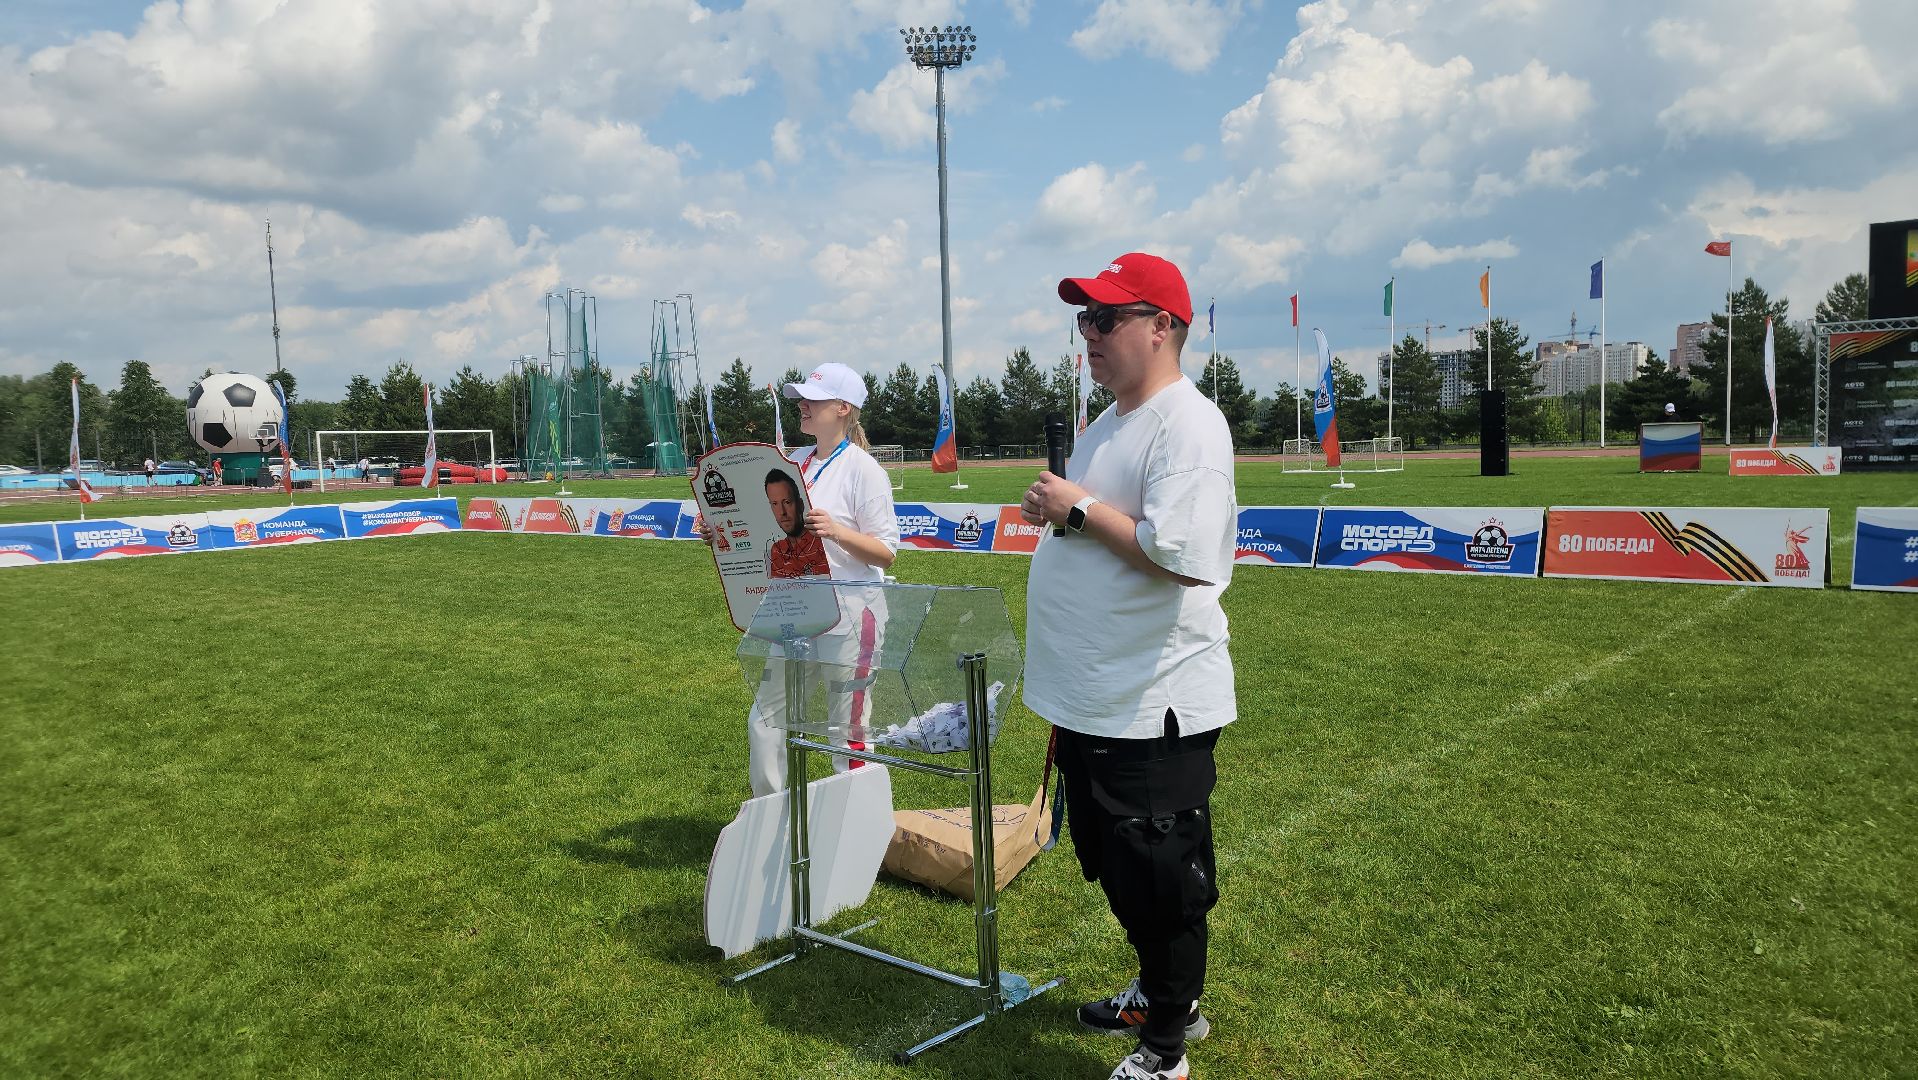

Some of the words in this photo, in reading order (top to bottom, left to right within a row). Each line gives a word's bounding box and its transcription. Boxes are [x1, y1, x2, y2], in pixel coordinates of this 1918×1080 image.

[263, 520, 307, 529] КОМАНДА
[265, 528, 325, 538] ГУБЕРНАТОРА
[1343, 525, 1434, 540] МОСОБЛ
[1341, 538, 1413, 552] СПОРТ
[1559, 534, 1583, 553] 80
[1586, 537, 1655, 555] ПОБЕДА!
[1775, 554, 1795, 568] 80
[1775, 569, 1810, 578] ПОБЕДА!
